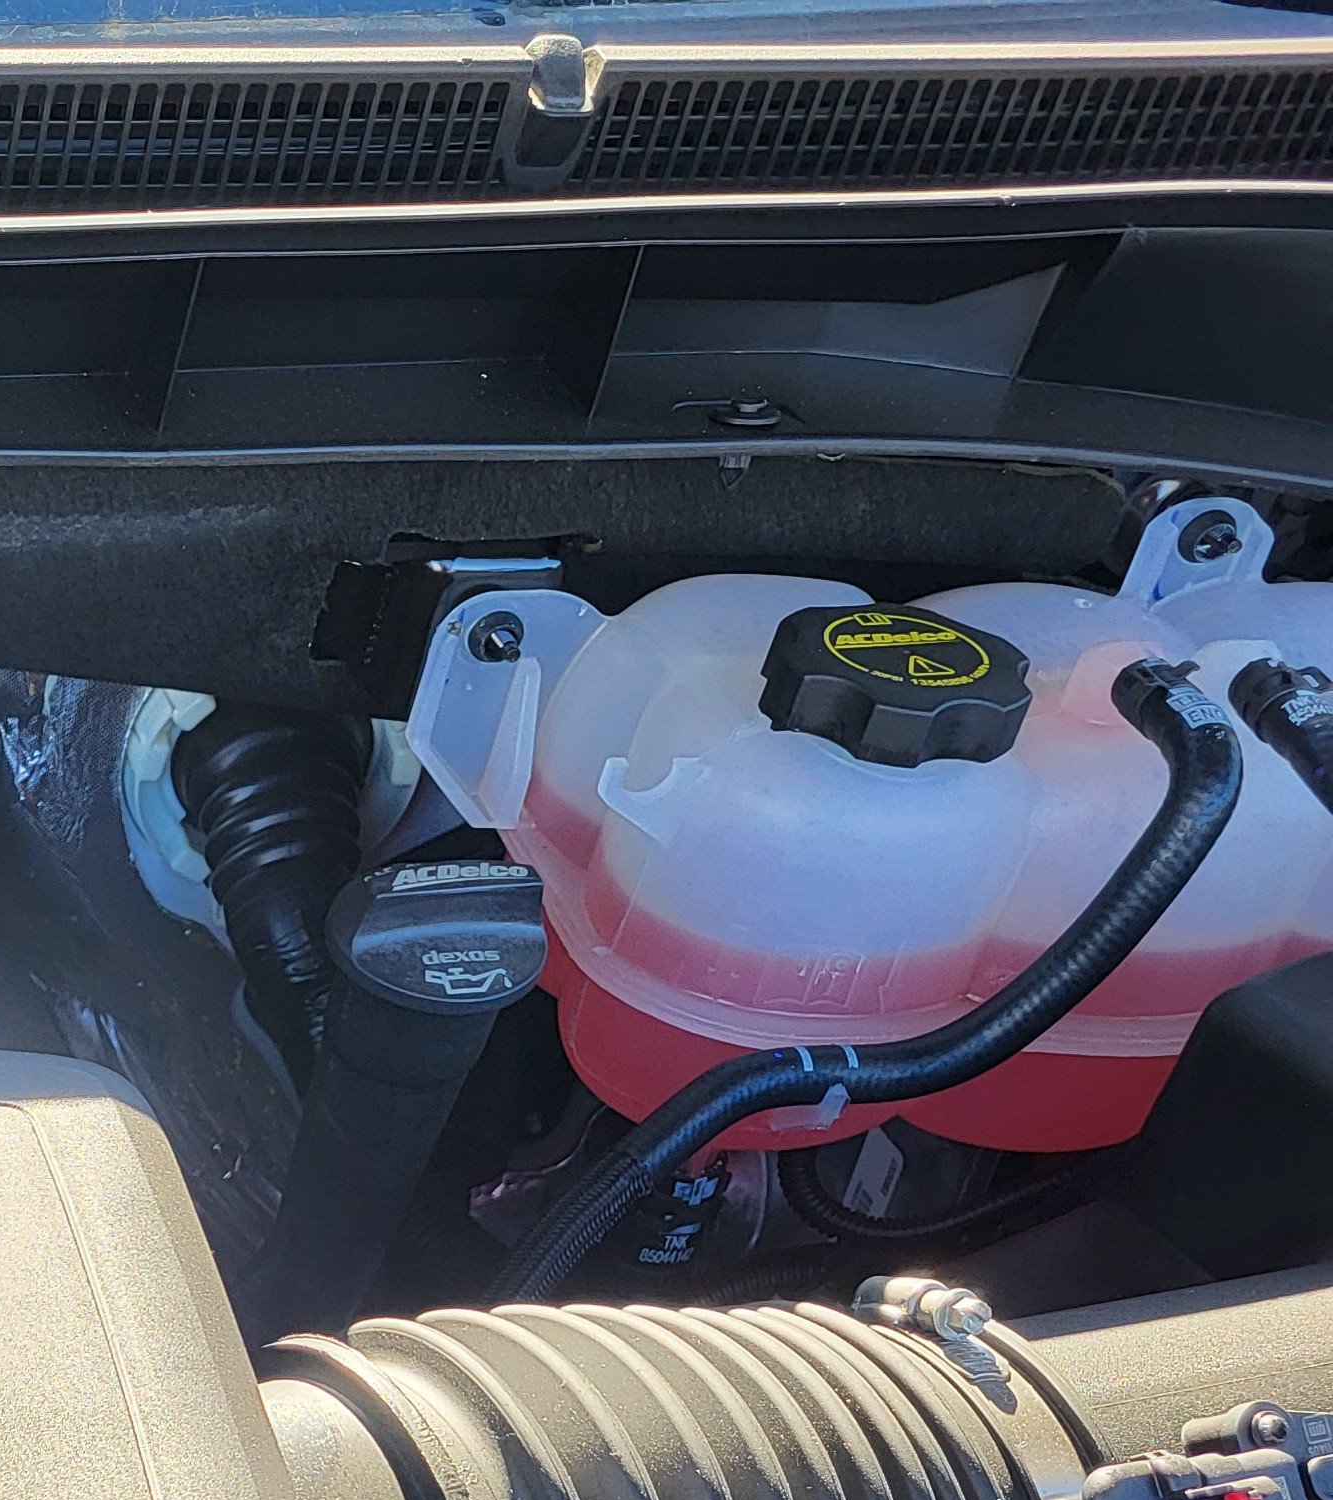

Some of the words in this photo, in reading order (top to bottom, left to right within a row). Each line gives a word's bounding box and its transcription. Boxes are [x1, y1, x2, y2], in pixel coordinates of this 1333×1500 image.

[835, 631, 958, 645] ACDelco
[393, 862, 529, 885] ACDelco
[421, 949, 501, 966] dexos
